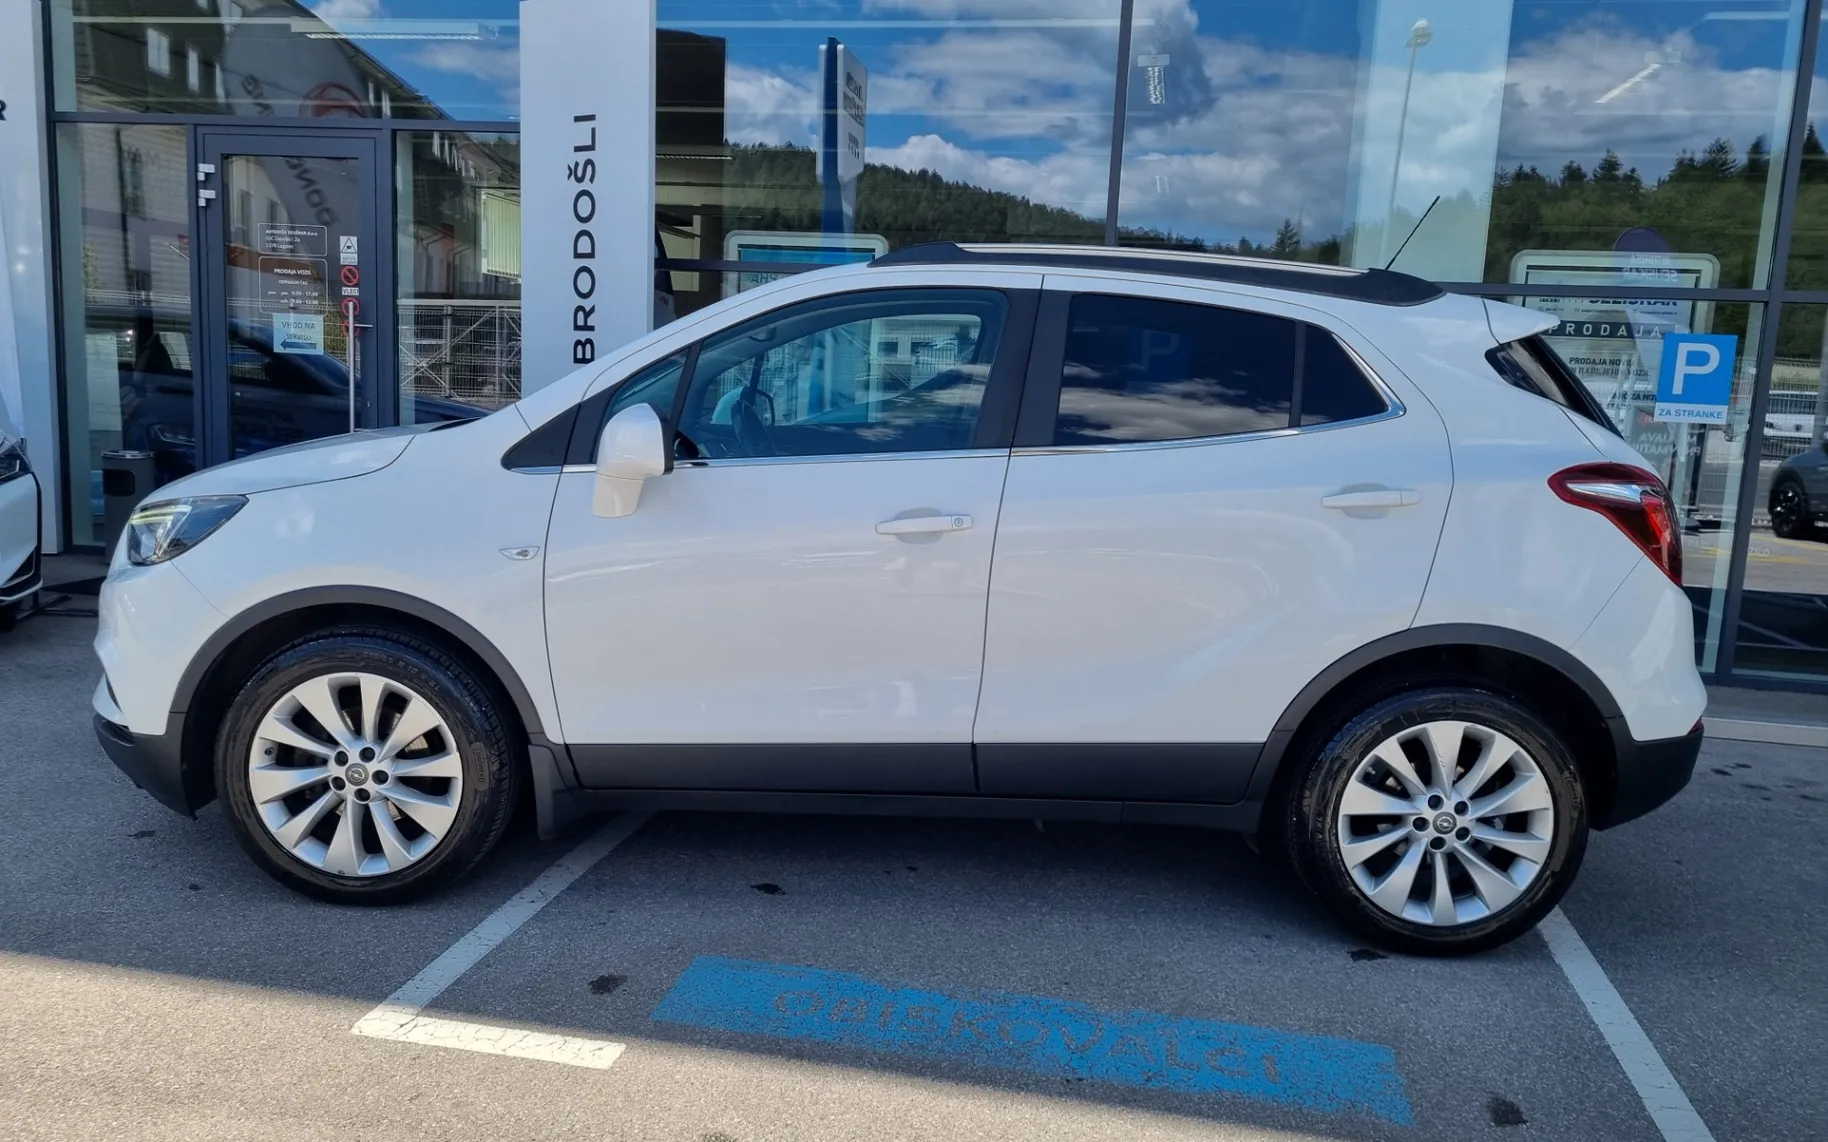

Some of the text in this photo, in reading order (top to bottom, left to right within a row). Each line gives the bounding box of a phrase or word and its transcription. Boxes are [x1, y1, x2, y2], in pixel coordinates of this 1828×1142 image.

[567, 113, 597, 365] BRODOŠLI
[282, 321, 316, 330] VHOD NA
[1569, 357, 1608, 366] PRODAJA
[1672, 342, 1721, 395] P
[1658, 408, 1672, 417] ZA
[1674, 409, 1723, 419] STRANKE
